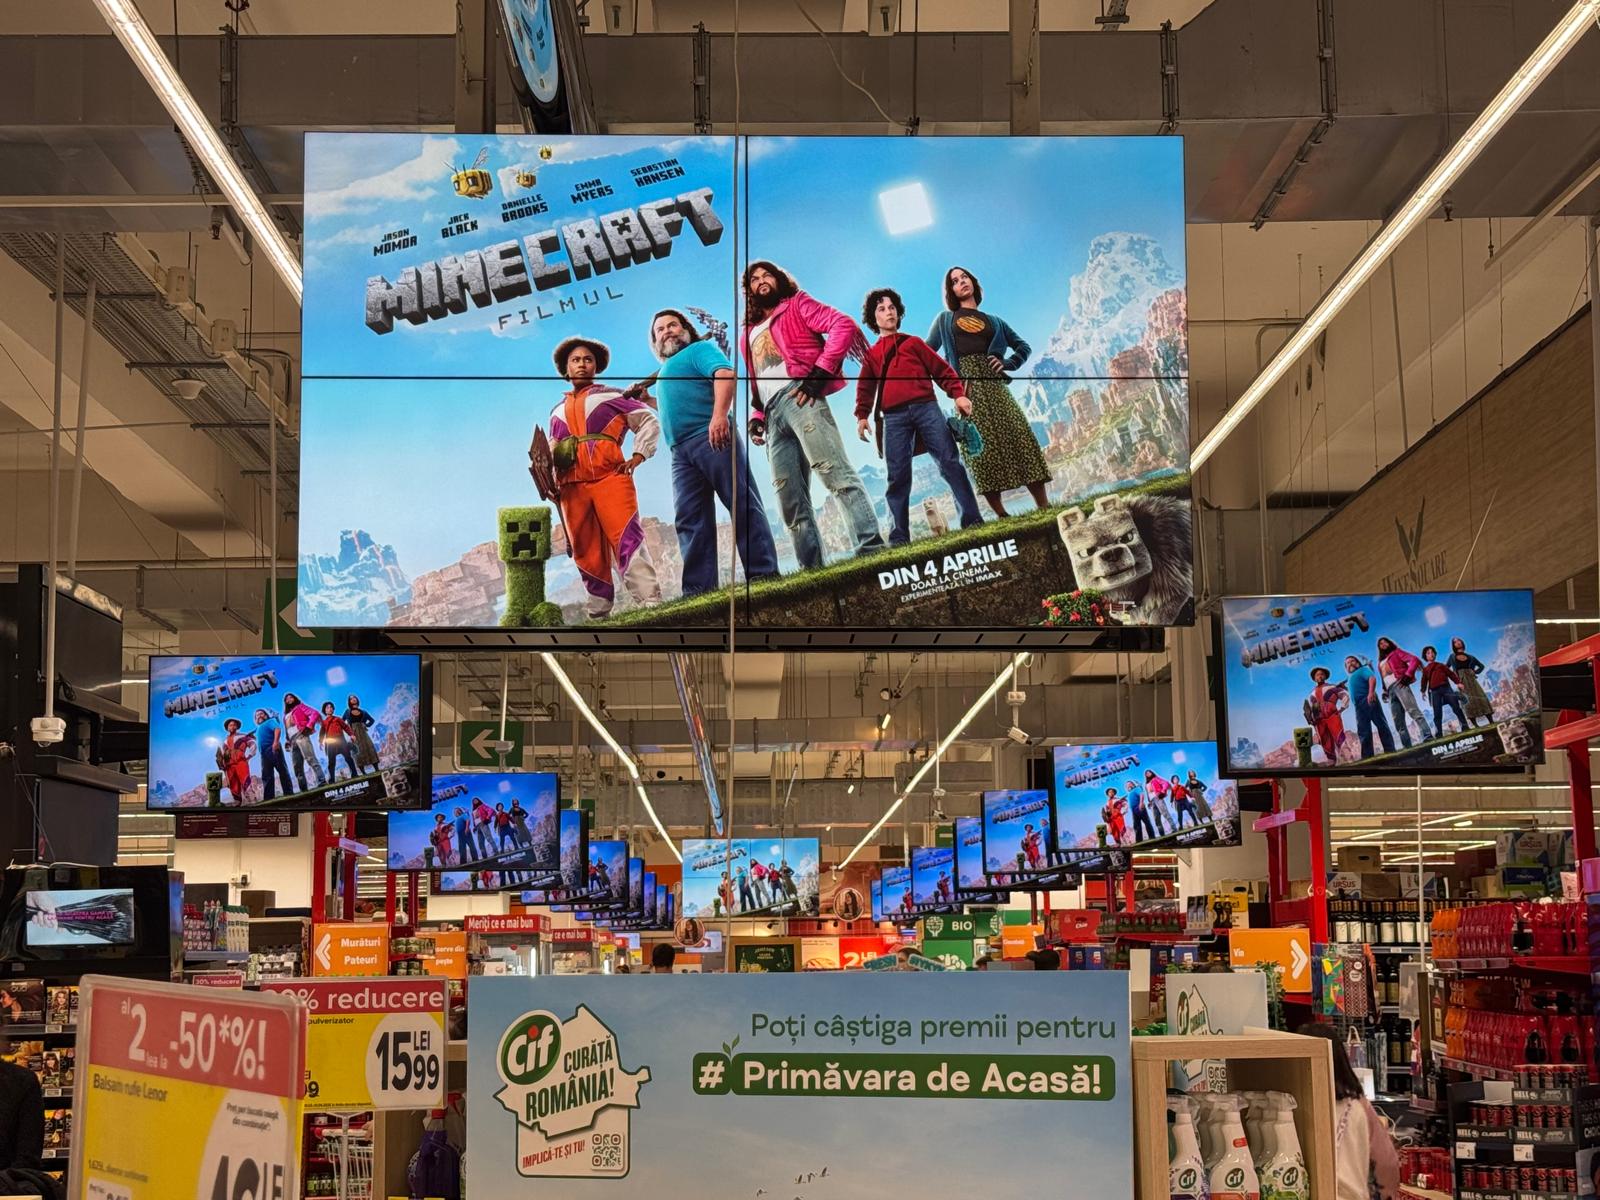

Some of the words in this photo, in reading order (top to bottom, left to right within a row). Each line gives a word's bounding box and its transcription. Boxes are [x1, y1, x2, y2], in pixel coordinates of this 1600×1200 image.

[630, 158, 679, 178] SEBASTIAN
[635, 166, 686, 188] HANSEN
[570, 184, 614, 205] MYERS
[574, 178, 603, 194] EMMA
[501, 194, 544, 213] DANIELLE
[501, 202, 549, 224] BROOKS
[441, 220, 479, 239] BLACK
[447, 212, 471, 227] JACK
[373, 235, 418, 257] MOMOA
[381, 228, 411, 244] JASON
[365, 187, 725, 335] MINECRAFT
[498, 286, 624, 331] FILMUL
[878, 564, 920, 591] DIN
[924, 560, 938, 578] 4
[943, 539, 1019, 574] APRILIE
[911, 577, 938, 592] DOAR
[939, 575, 951, 584] LA
[952, 565, 990, 581] CINEMA
[975, 570, 1003, 584] IMAX
[1241, 611, 1370, 669] MINECRAFT
[164, 670, 279, 719] MINECRAFT
[1431, 744, 1448, 756] DIN
[1455, 734, 1484, 749] APRILIE
[1064, 753, 1141, 788] MINECRAFT
[324, 789, 338, 798] DIN
[345, 781, 370, 793] APRILIE
[1333, 881, 1356, 889] URSUS
[468, 917, 490, 932] Meriți
[491, 919, 499, 928] ce
[500, 919, 505, 928] e
[507, 917, 519, 928] mai
[520, 917, 534, 928] bun
[567, 930, 577, 939] mai
[577, 930, 587, 939] bun
[951, 921, 972, 931] BIO
[341, 937, 381, 948] Murături
[1233, 948, 1245, 957] Vin
[344, 955, 378, 966] Pateuri
[327, 988, 443, 1010] reducere
[121, 997, 131, 1015] al
[128, 1003, 147, 1061] 2
[159, 1054, 168, 1069] la
[751, 1013, 806, 1046] Poți
[814, 1013, 912, 1046] câștiga
[920, 1014, 1007, 1045] premii
[1016, 1016, 1116, 1046] pentru
[413, 1031, 430, 1051] LEI
[507, 1024, 554, 1077] Cif
[375, 1031, 412, 1091] 15
[563, 1034, 614, 1073] CURĂȚĂ
[413, 1054, 439, 1090] 99
[698, 1061, 726, 1089] #
[744, 1061, 917, 1091] Primăvara
[926, 1063, 971, 1092] de
[982, 1063, 1101, 1095] Acasă!
[93, 1073, 123, 1093] Balsam
[124, 1082, 141, 1098] rufe
[143, 1083, 168, 1102] Lenor
[526, 1068, 615, 1122] ROMÂNIA!
[1457, 1128, 1471, 1138] HELL
[1516, 1131, 1533, 1140] HELL
[522, 1146, 563, 1168] IMPLICĂ-TE
[564, 1145, 572, 1161] ȘI
[572, 1140, 586, 1156] TU!
[1181, 1172, 1196, 1186] Cif
[1227, 1171, 1243, 1185] Cif
[1284, 1170, 1298, 1184] Cif
